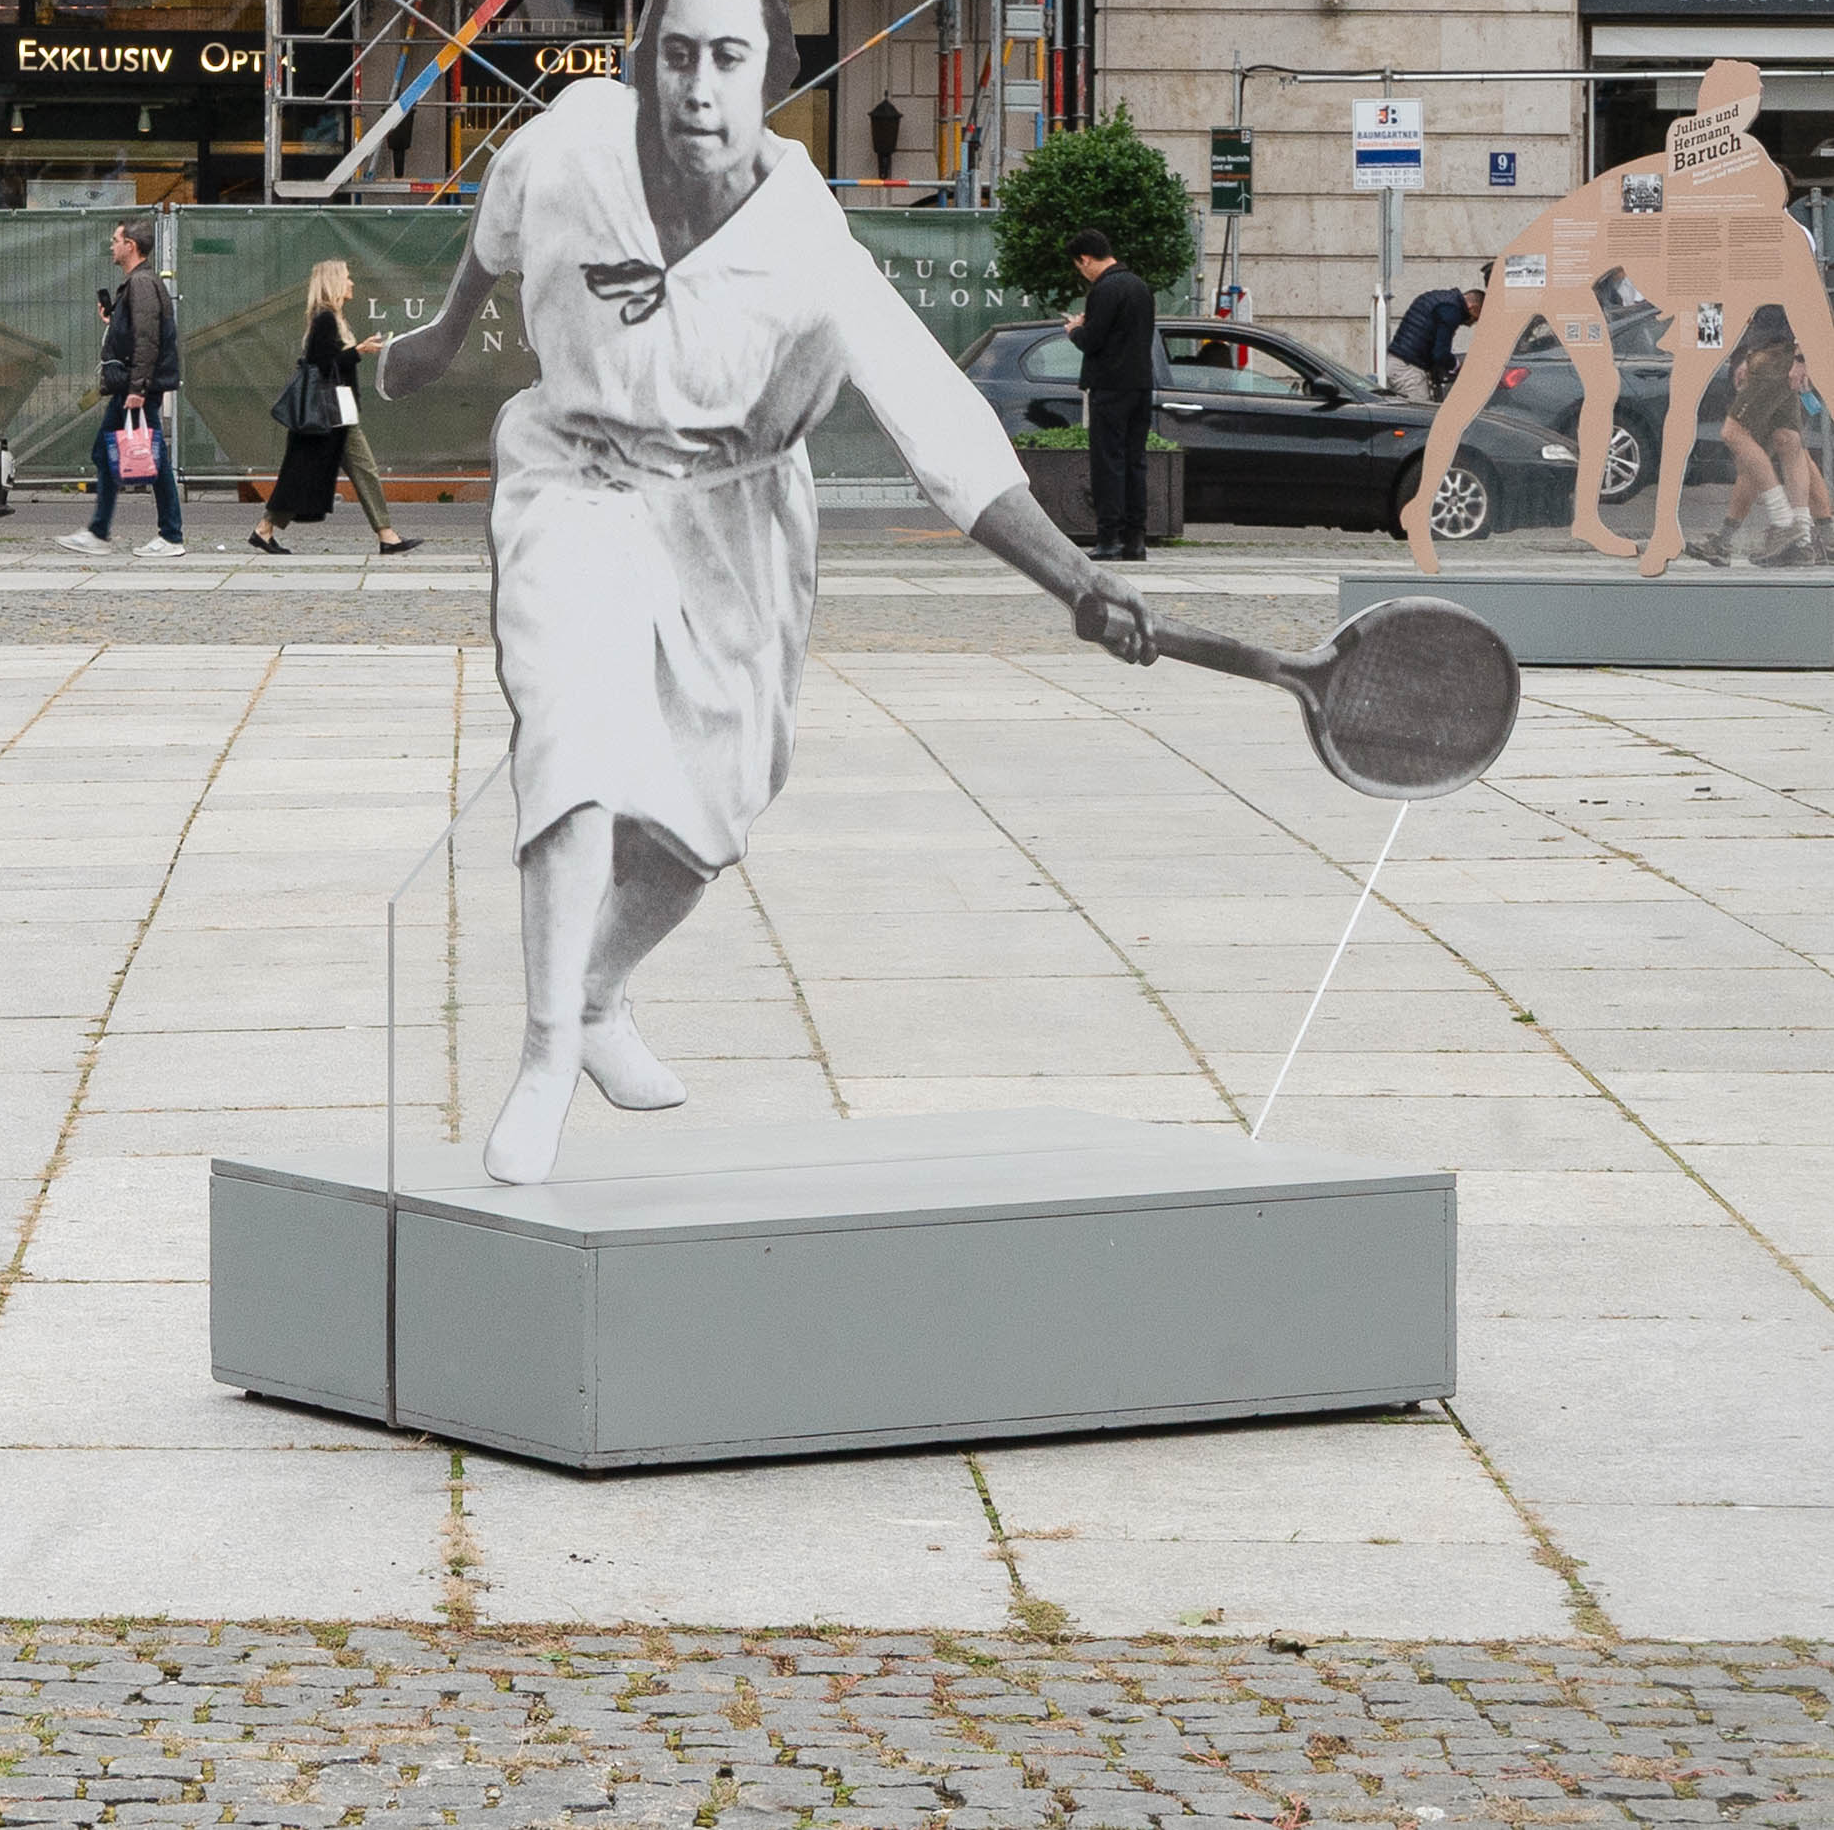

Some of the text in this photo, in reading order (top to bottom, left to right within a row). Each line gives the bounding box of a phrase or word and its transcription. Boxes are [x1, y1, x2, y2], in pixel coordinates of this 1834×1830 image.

[1674, 104, 1739, 137] Julius und
[1357, 130, 1418, 139] BAUMGARTNER
[1674, 125, 1730, 152] Hermann
[1497, 154, 1508, 170] 9
[1673, 133, 1742, 172] Baruch
[884, 259, 1001, 279] LUCA
[367, 298, 501, 319] LUA
